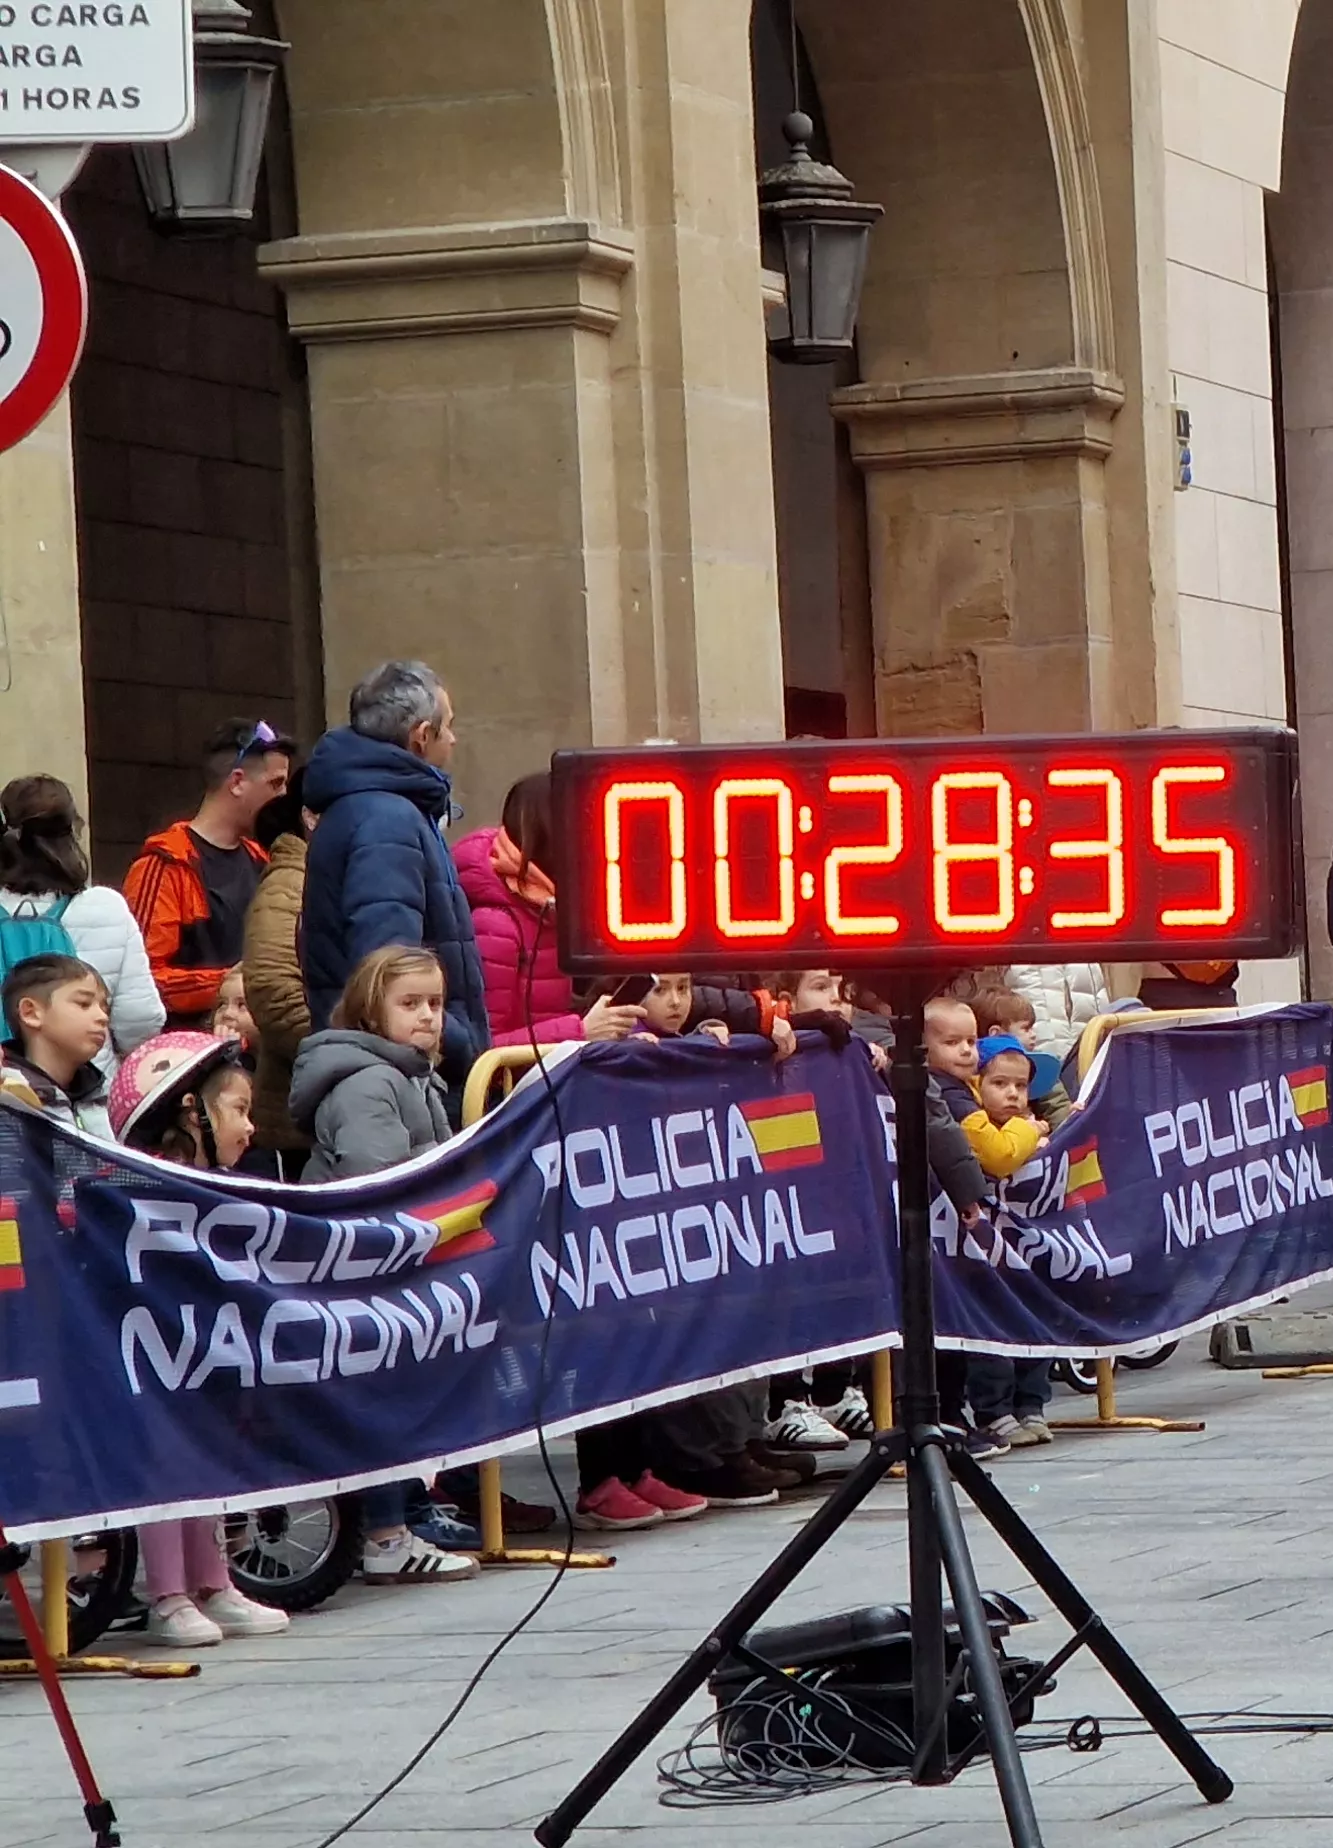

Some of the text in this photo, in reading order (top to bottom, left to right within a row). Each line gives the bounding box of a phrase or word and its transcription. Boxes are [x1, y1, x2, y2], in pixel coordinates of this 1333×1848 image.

[31, 4, 150, 26] CARGA
[23, 87, 141, 110] HORAS
[604, 765, 1237, 941] 00:28:35
[530, 1185, 836, 1320] NACIONAL
[121, 1272, 499, 1396] NACIONAL
